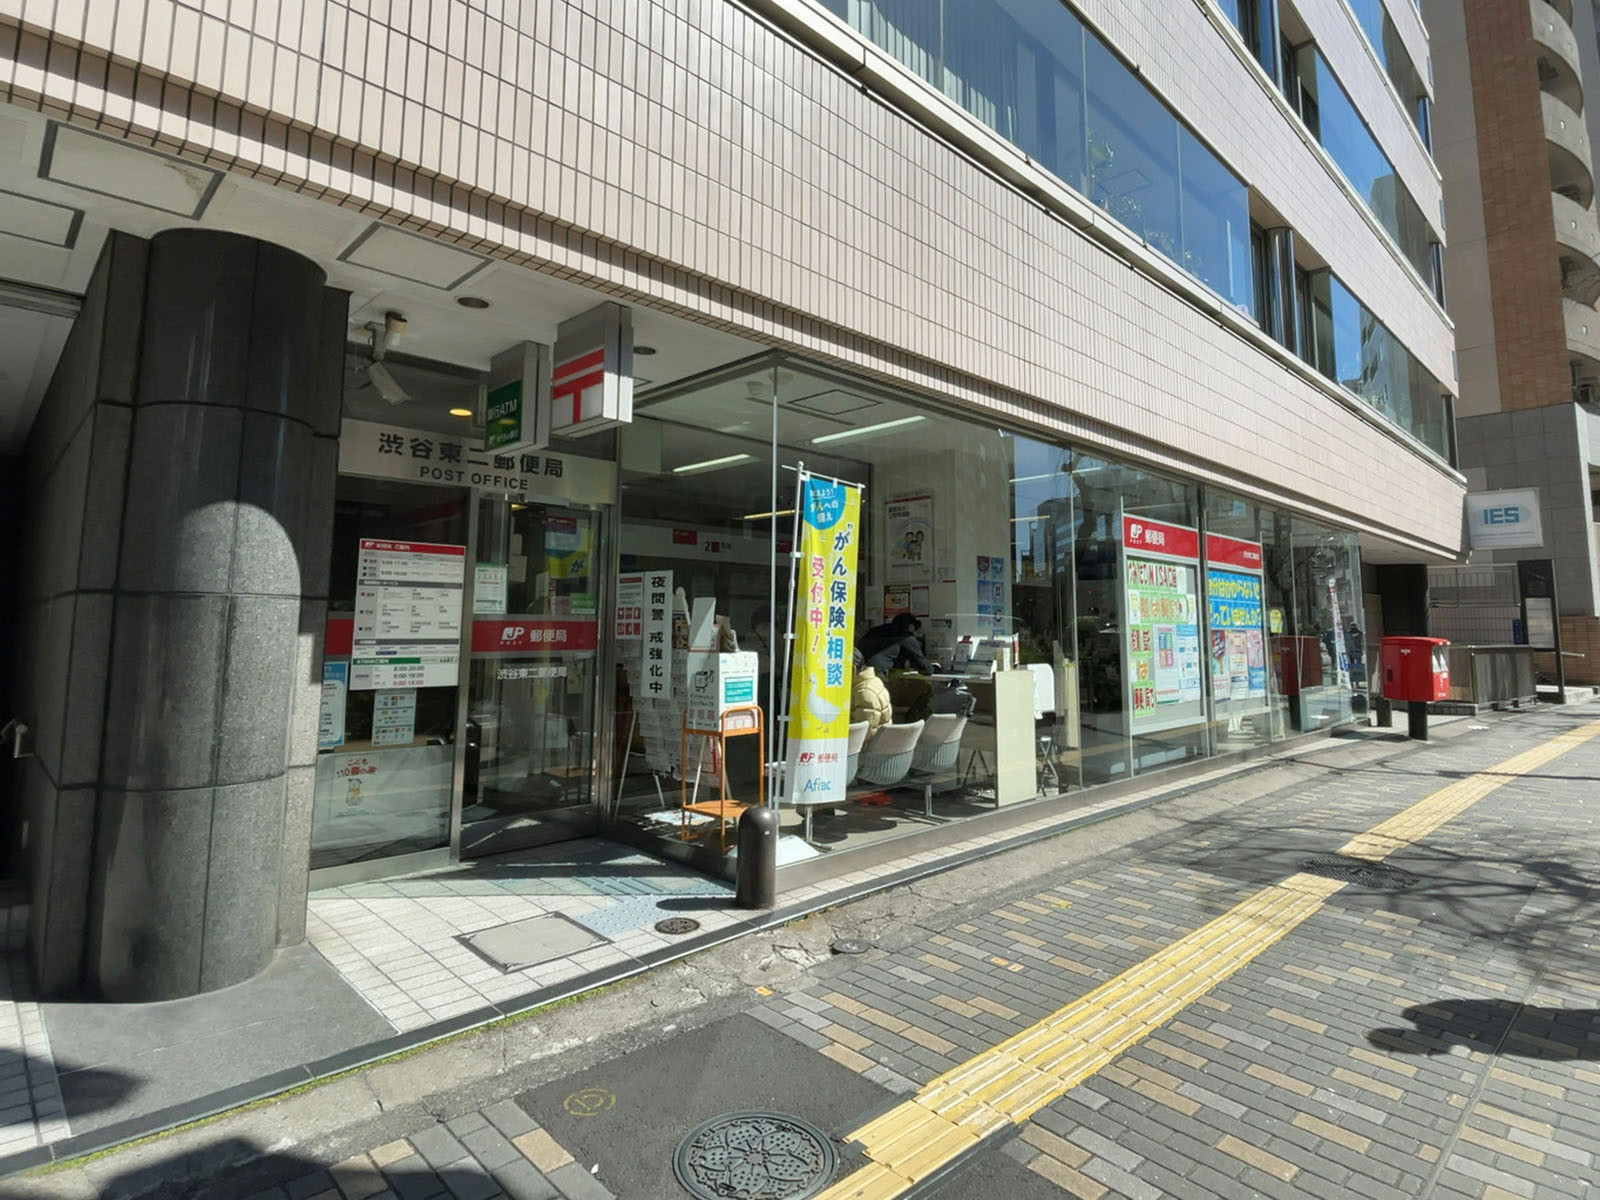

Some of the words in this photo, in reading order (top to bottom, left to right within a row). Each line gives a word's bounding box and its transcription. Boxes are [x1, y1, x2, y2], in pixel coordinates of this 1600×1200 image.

[378, 432, 564, 478] 渋谷東二郵便局
[420, 466, 465, 482] POST
[471, 473, 528, 491] OFFICE
[1484, 507, 1519, 525] IES
[1145, 529, 1165, 546] 郵便局
[530, 629, 567, 643] 郵便局
[648, 576, 666, 694] 夜間警戒強化中
[497, 666, 567, 680] 渋谷東二郵便局
[803, 779, 830, 793] Aflac
